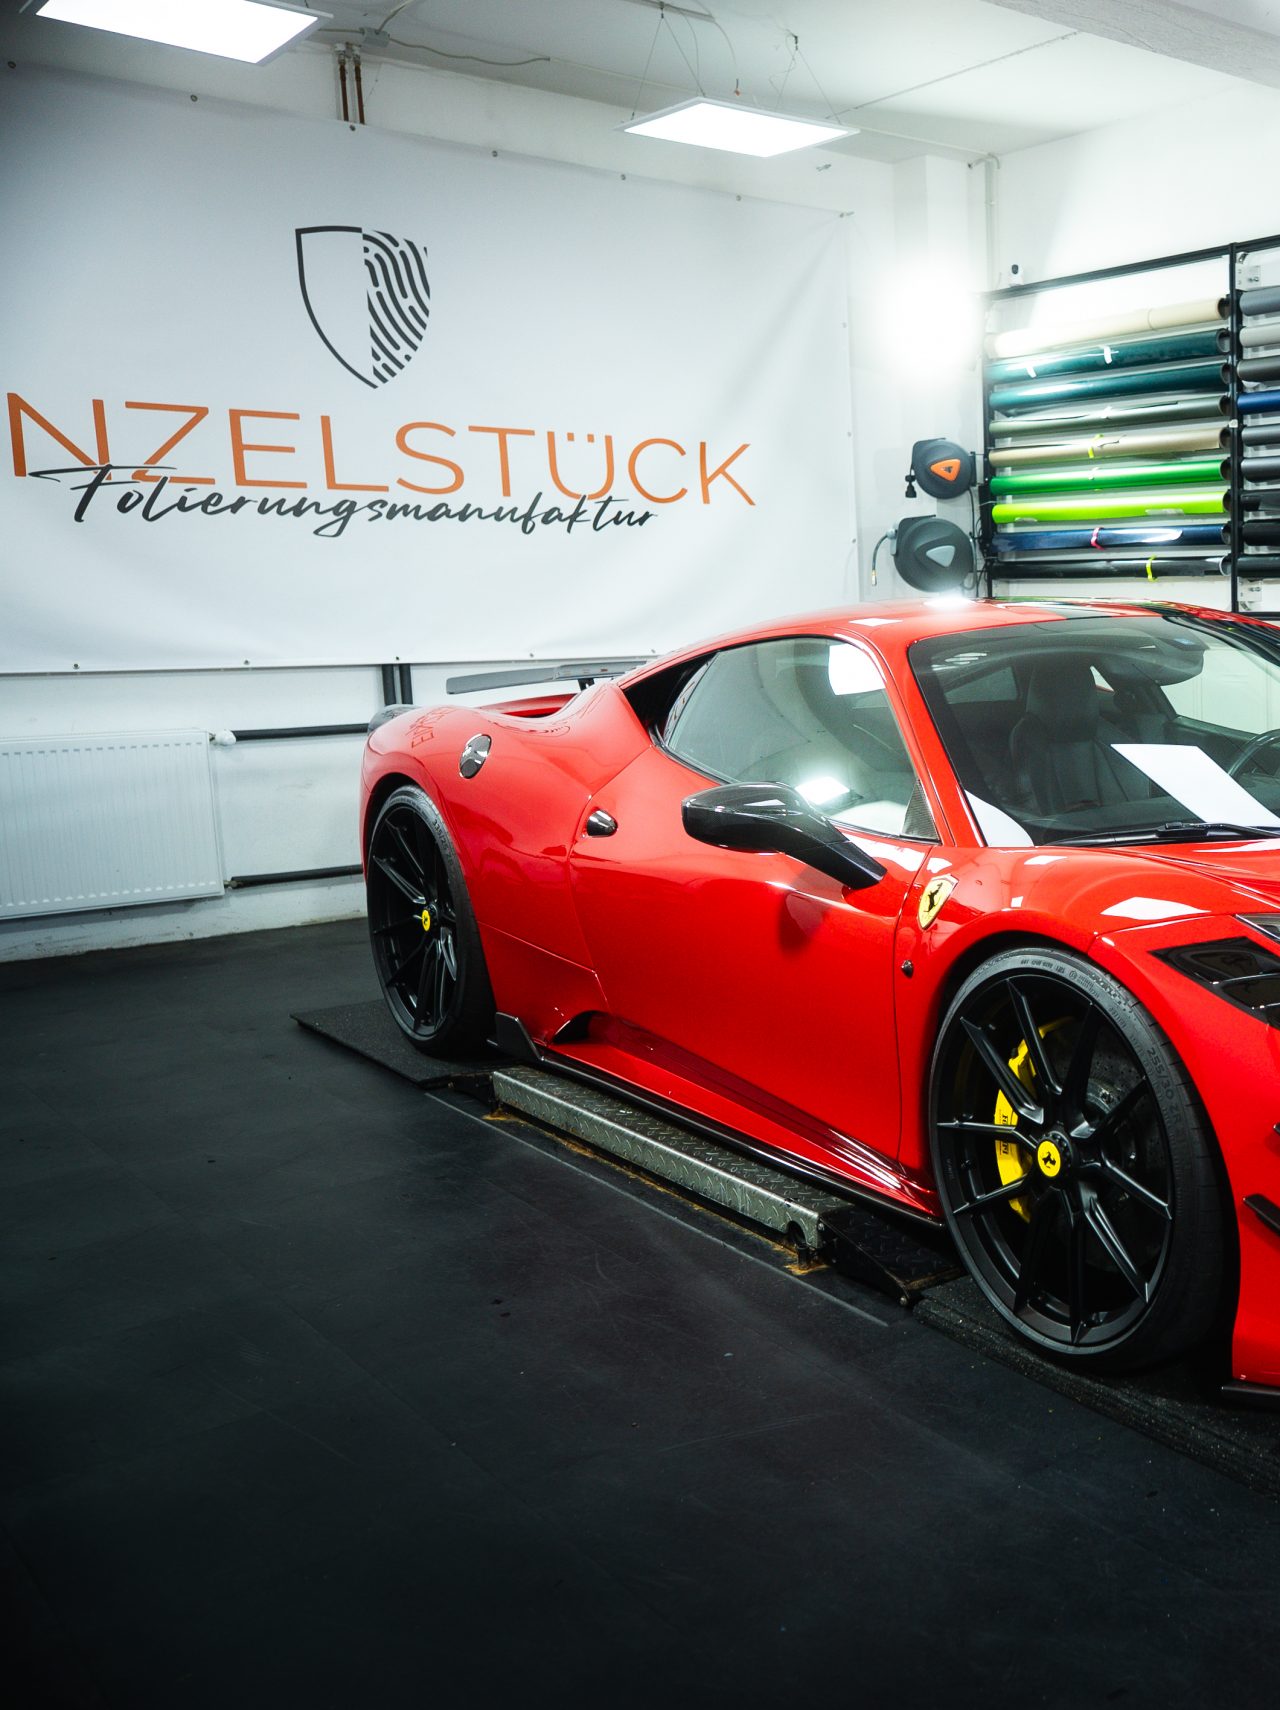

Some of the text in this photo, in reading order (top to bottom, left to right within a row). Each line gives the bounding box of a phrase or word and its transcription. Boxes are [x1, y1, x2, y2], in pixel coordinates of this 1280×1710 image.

[7, 392, 756, 506] NZELSTÜCK
[28, 464, 658, 538] Folierungsmanufaktur
[1147, 1046, 1174, 1100] 255/30
